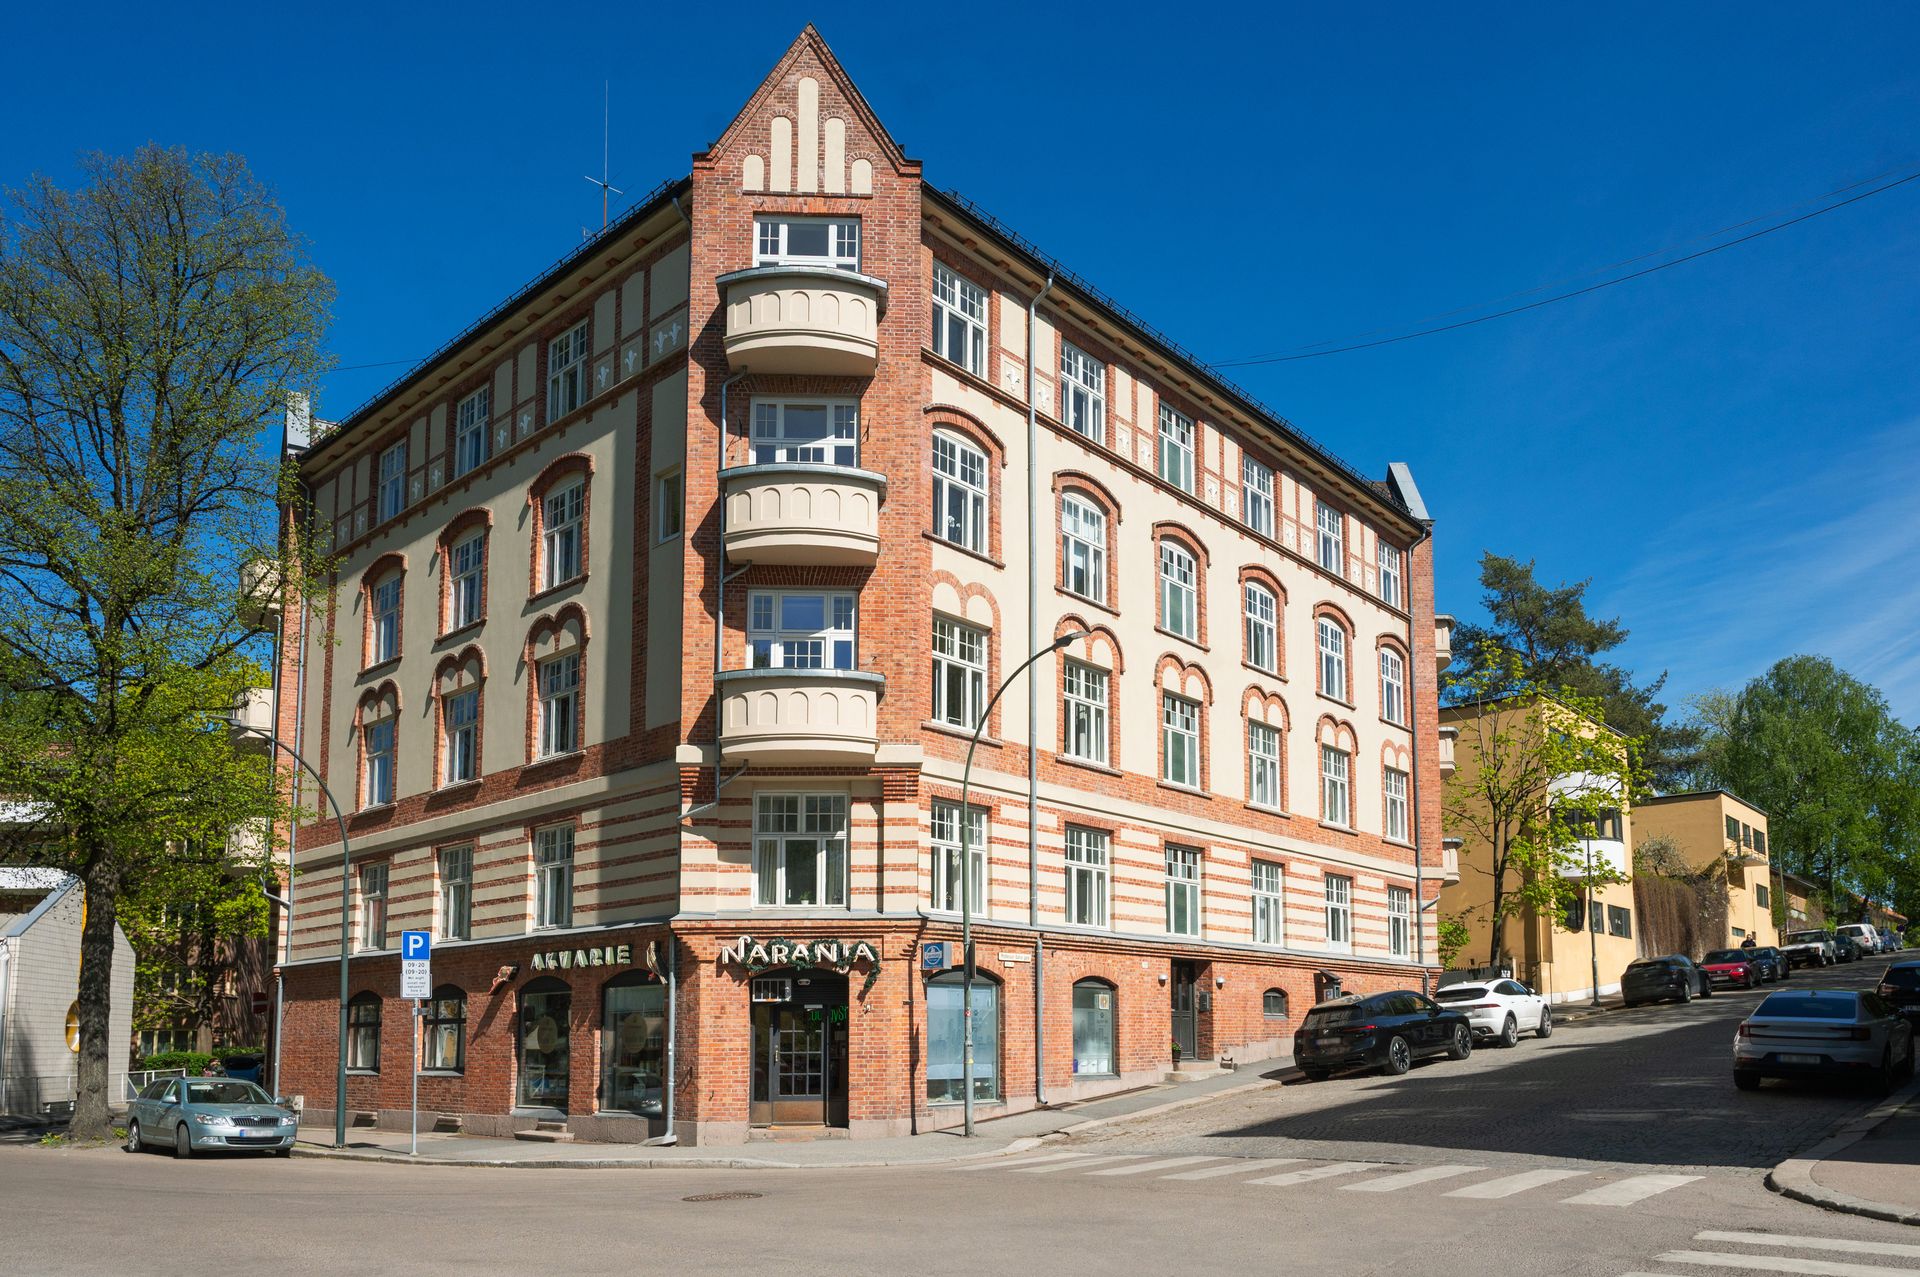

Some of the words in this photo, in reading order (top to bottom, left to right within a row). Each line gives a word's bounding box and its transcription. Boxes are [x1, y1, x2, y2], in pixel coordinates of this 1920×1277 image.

[409, 935, 424, 957] P
[530, 945, 631, 971] AKVARIE
[721, 935, 875, 974] NARANJA
